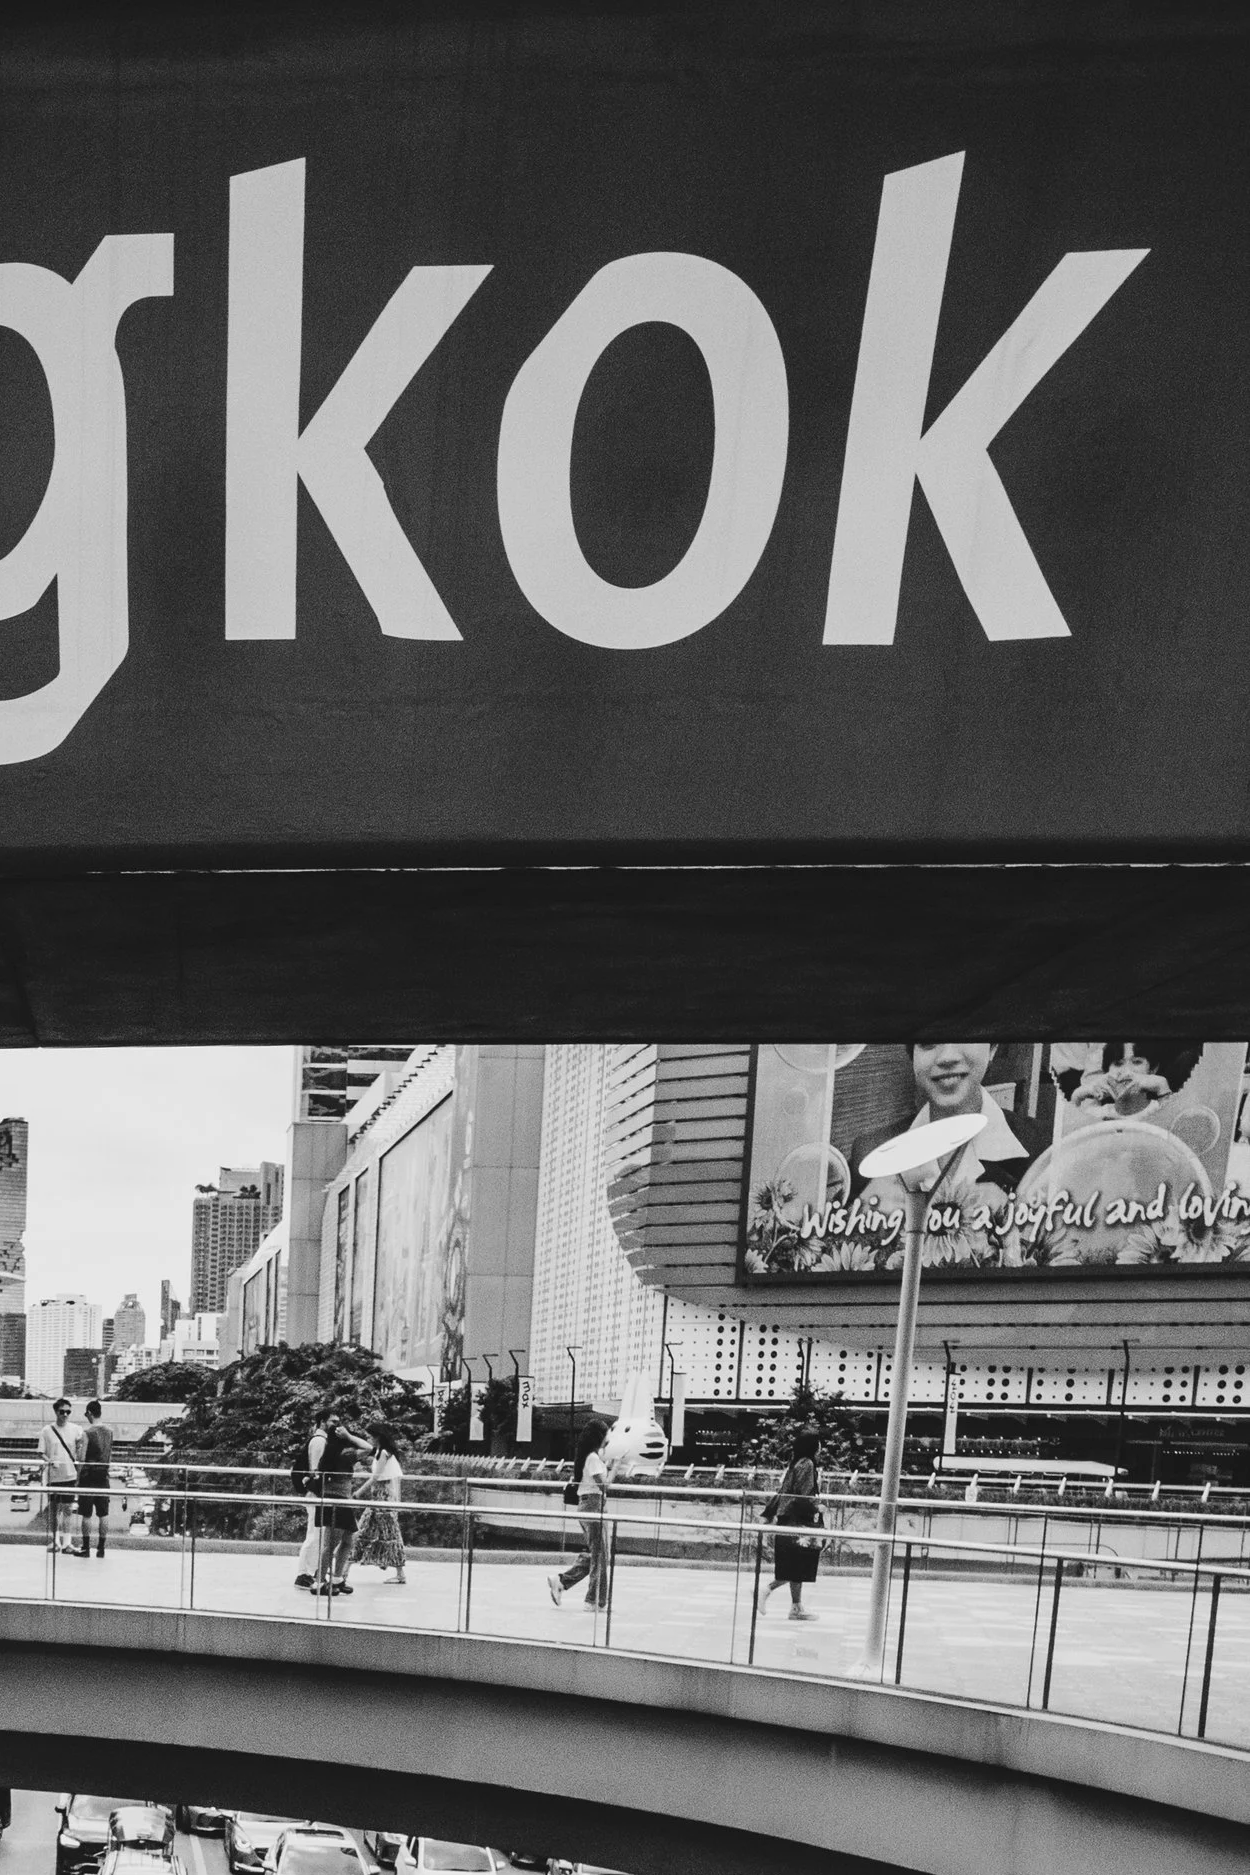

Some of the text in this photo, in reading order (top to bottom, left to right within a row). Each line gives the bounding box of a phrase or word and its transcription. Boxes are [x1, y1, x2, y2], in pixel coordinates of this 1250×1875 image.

[800, 1195, 904, 1247] Wishing
[924, 1206, 961, 1232] ou
[972, 1205, 993, 1230] a
[996, 1190, 1098, 1242] joyful
[1105, 1183, 1166, 1228] and
[521, 1380, 531, 1409] max
